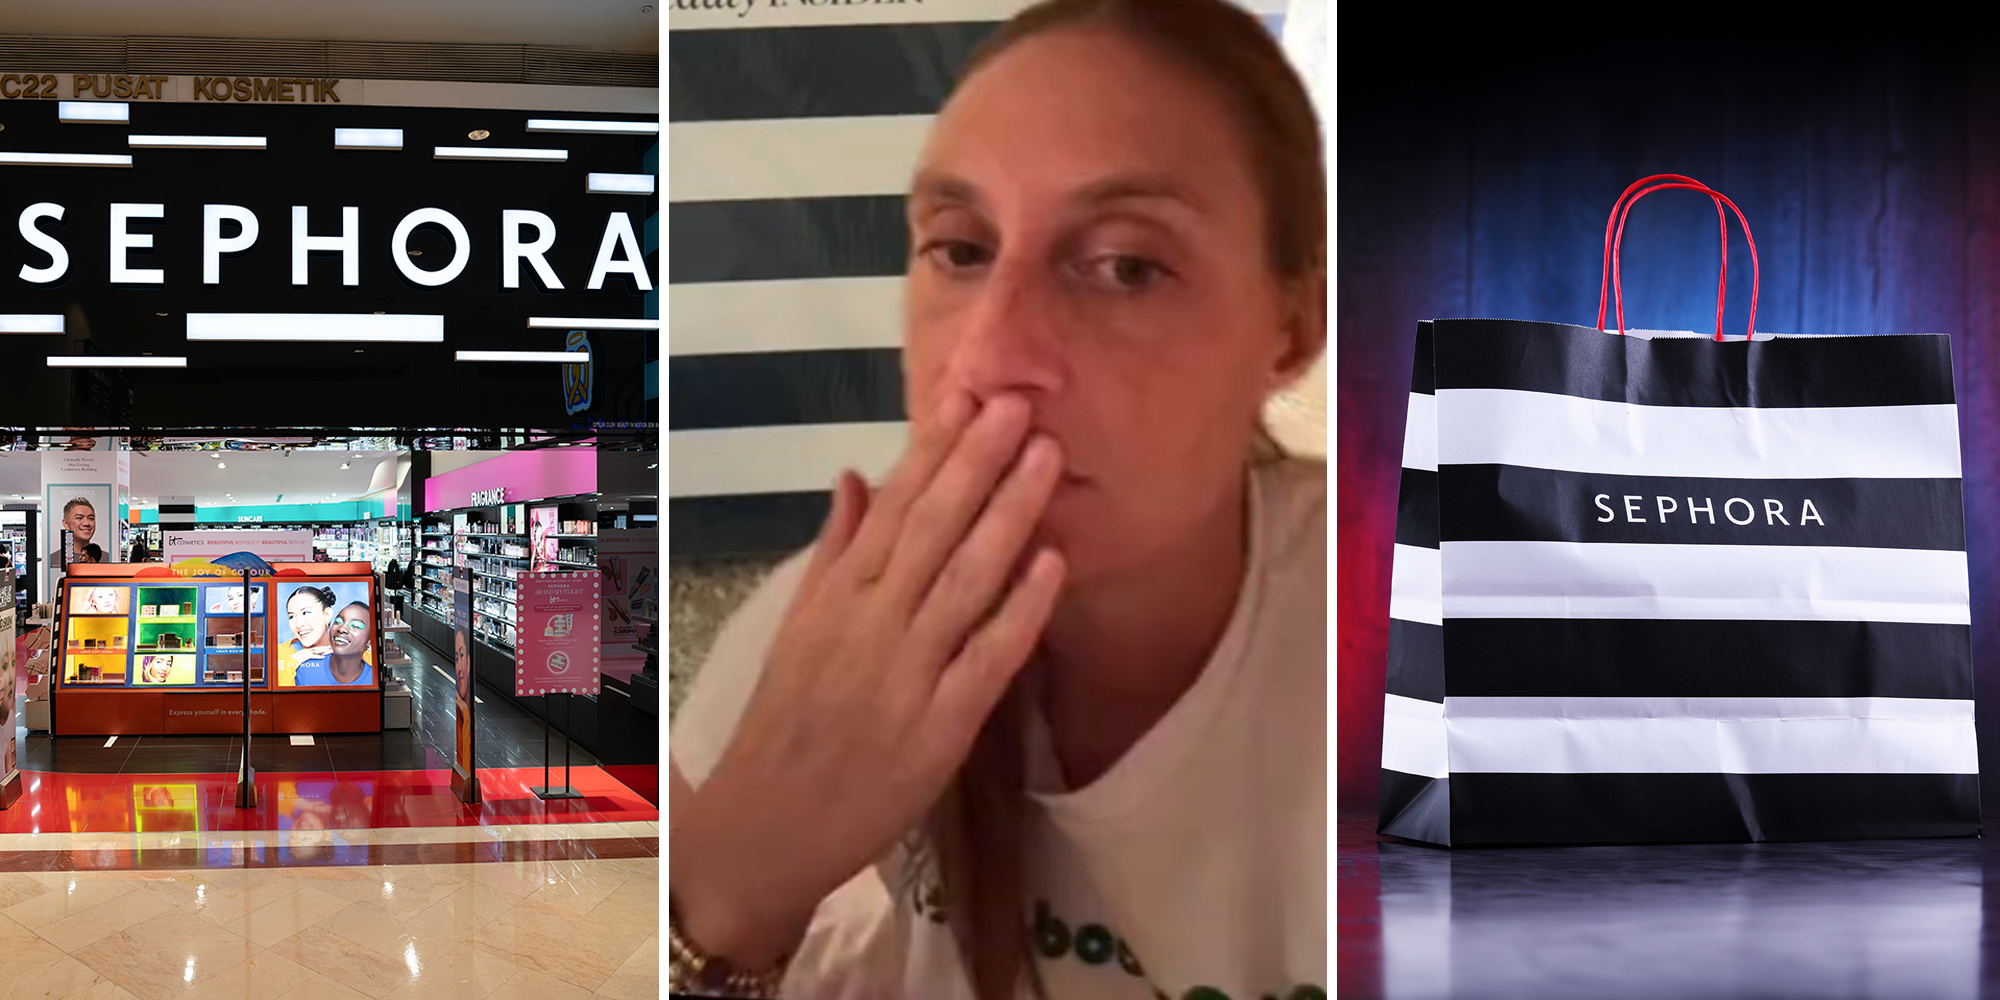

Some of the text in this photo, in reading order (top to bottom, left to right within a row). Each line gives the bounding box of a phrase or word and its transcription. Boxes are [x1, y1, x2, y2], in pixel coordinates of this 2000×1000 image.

[0, 74, 341, 102] C22 PUSAT KOSMETIK
[18, 202, 653, 291] SEPHORA
[471, 487, 505, 507] FRAGRANCE
[1594, 493, 1825, 527] SEPHORA
[171, 568, 271, 576] THE JOY OF COOUR
[169, 709, 193, 717] Express
[194, 709, 219, 717] yourself
